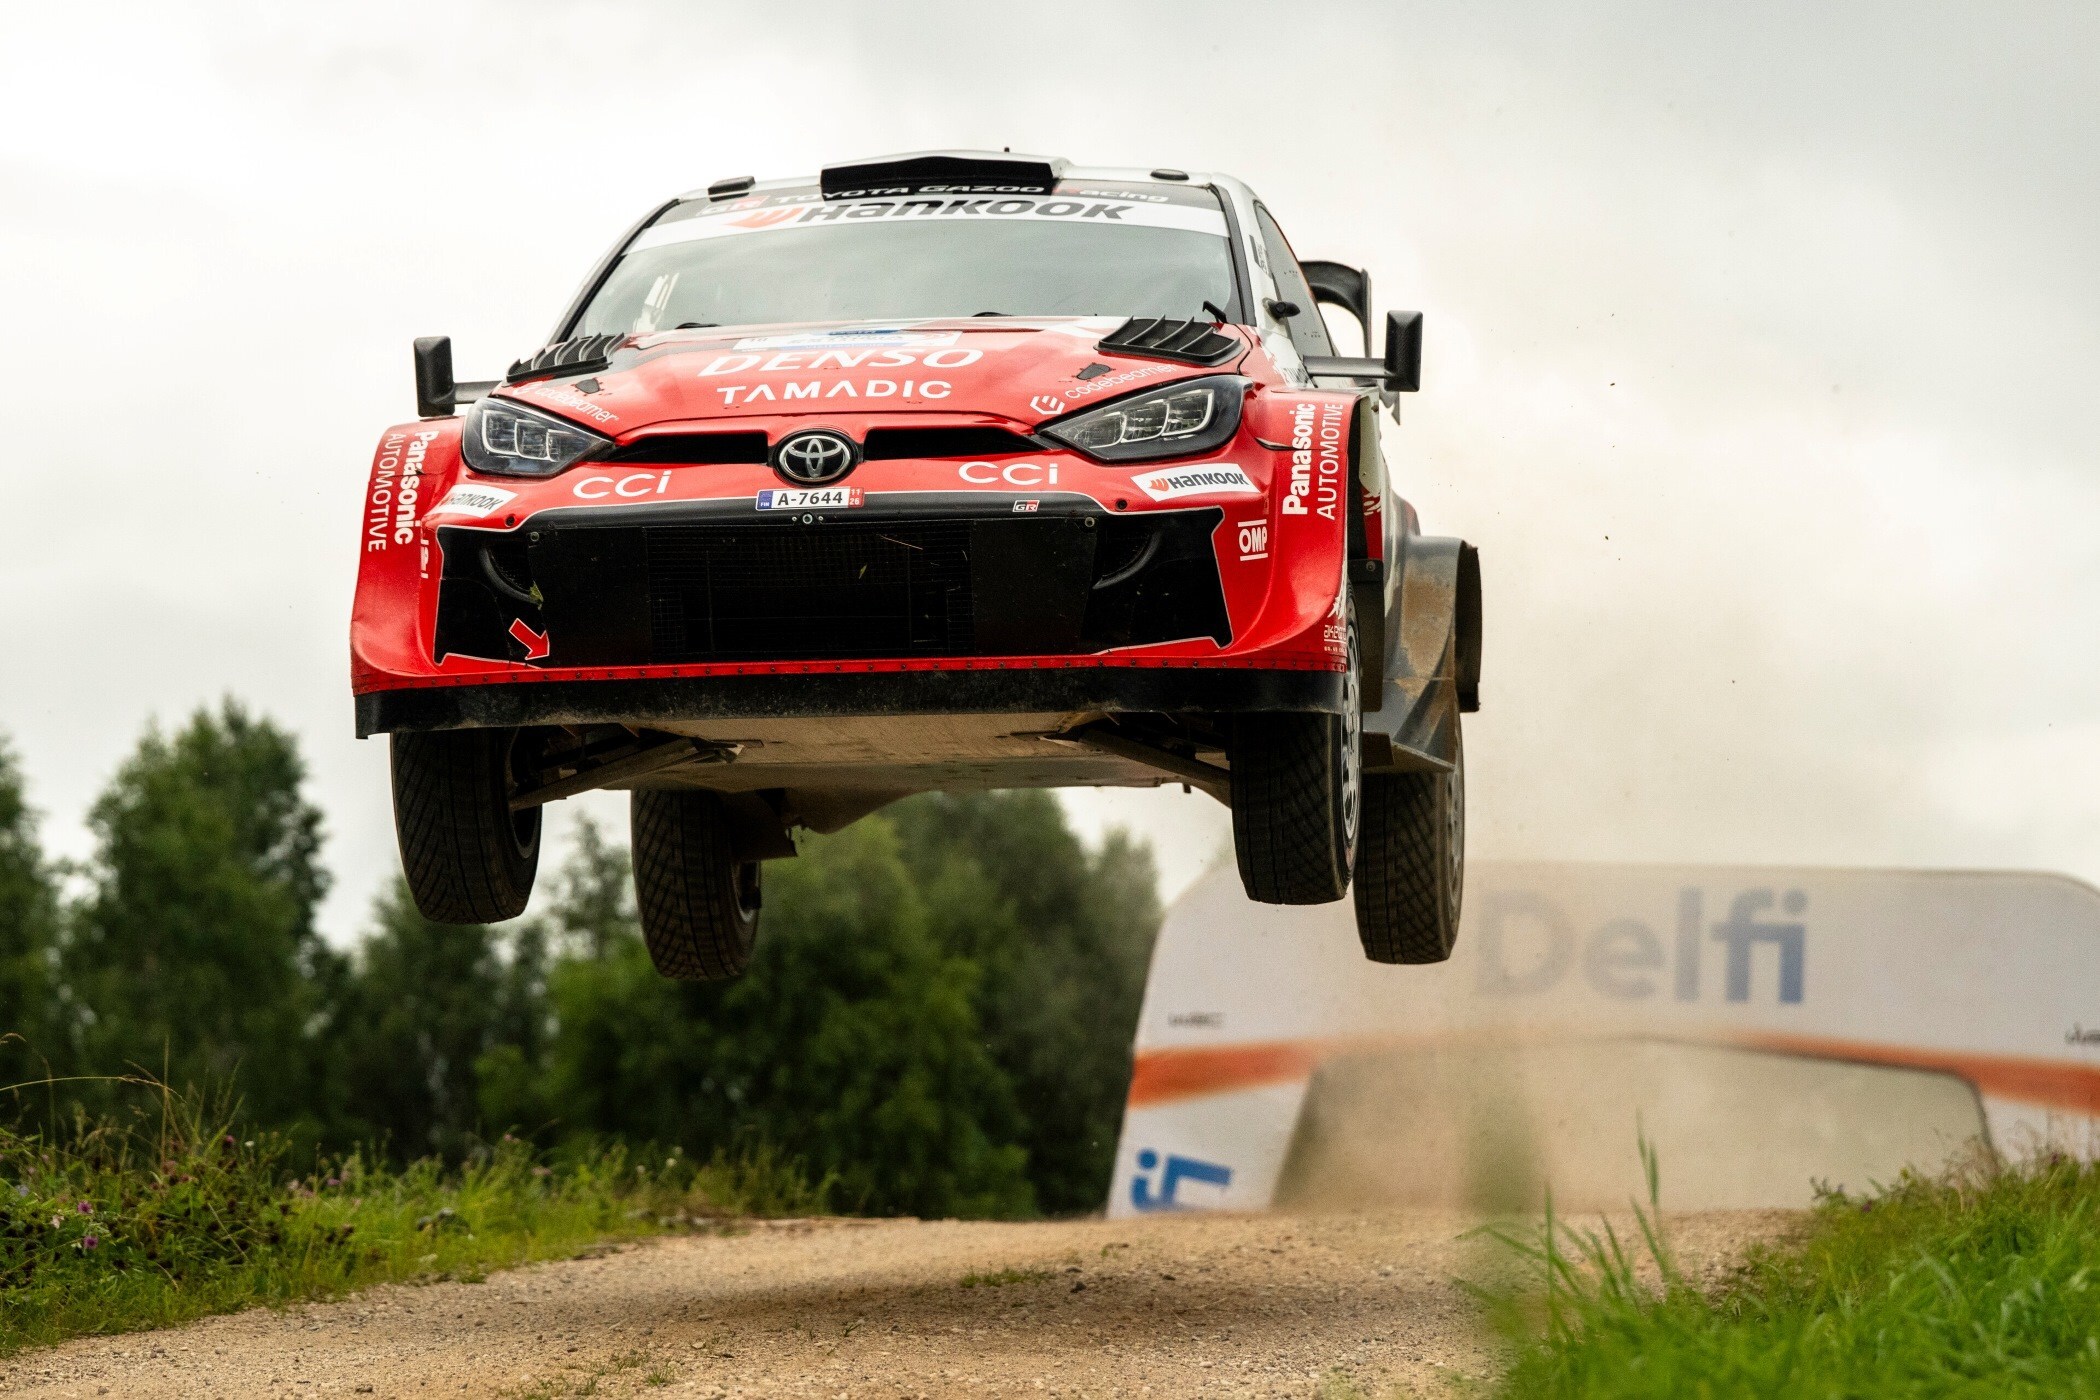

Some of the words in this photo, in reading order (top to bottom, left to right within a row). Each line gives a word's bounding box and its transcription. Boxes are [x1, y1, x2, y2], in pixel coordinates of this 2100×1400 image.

[775, 186, 909, 204] TOYOTA
[918, 185, 1045, 193] GAZOO
[697, 349, 984, 376] DENSO
[716, 380, 953, 405] TAMADIC
[1064, 363, 1177, 399] codebeamer
[1282, 403, 1316, 515] Panasonic
[1316, 403, 1344, 521] AUTOMOTIVE
[368, 433, 406, 552] AUTOMOTIVE
[394, 430, 439, 545] Panasonic
[777, 491, 843, 506] A-7644
[1015, 502, 1038, 511] GR
[1238, 526, 1268, 554] OMP
[1474, 887, 1808, 1004] Delfi
